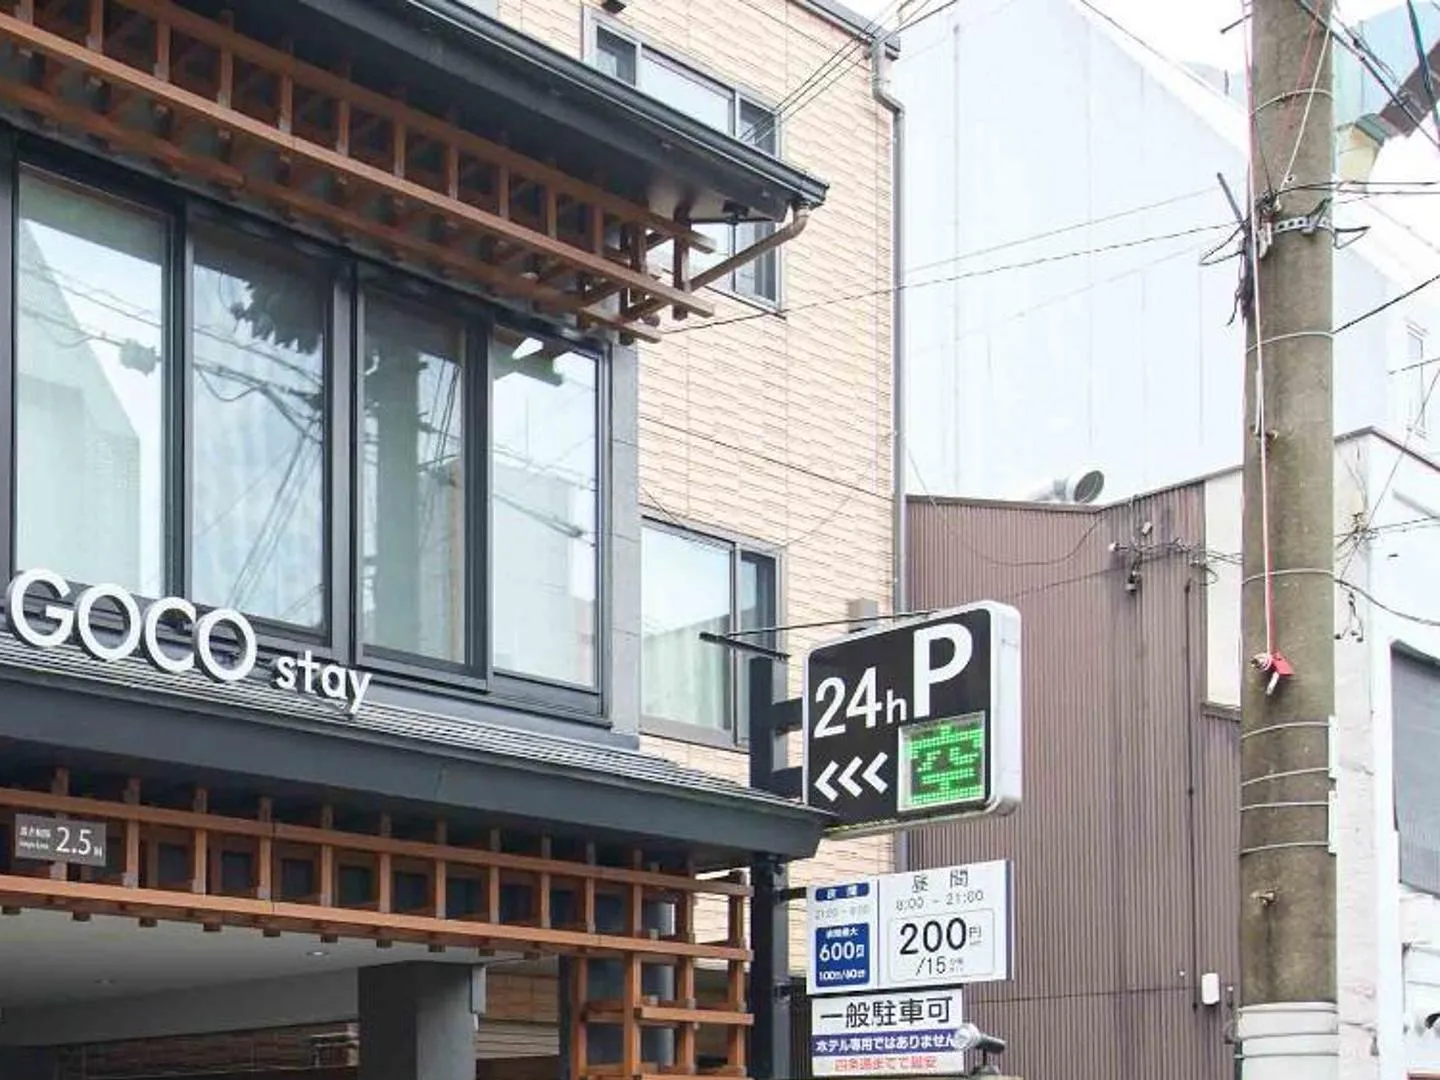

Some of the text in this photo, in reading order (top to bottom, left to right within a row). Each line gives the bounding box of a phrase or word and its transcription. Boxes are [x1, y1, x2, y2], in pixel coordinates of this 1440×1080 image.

[6, 567, 257, 682] GOCO
[270, 648, 372, 714] stay
[813, 622, 973, 738] 24h P
[56, 826, 92, 855] 2.5
[820, 996, 953, 1028] 一般駐車可
[815, 1033, 956, 1053] ホテル専用ではありません
